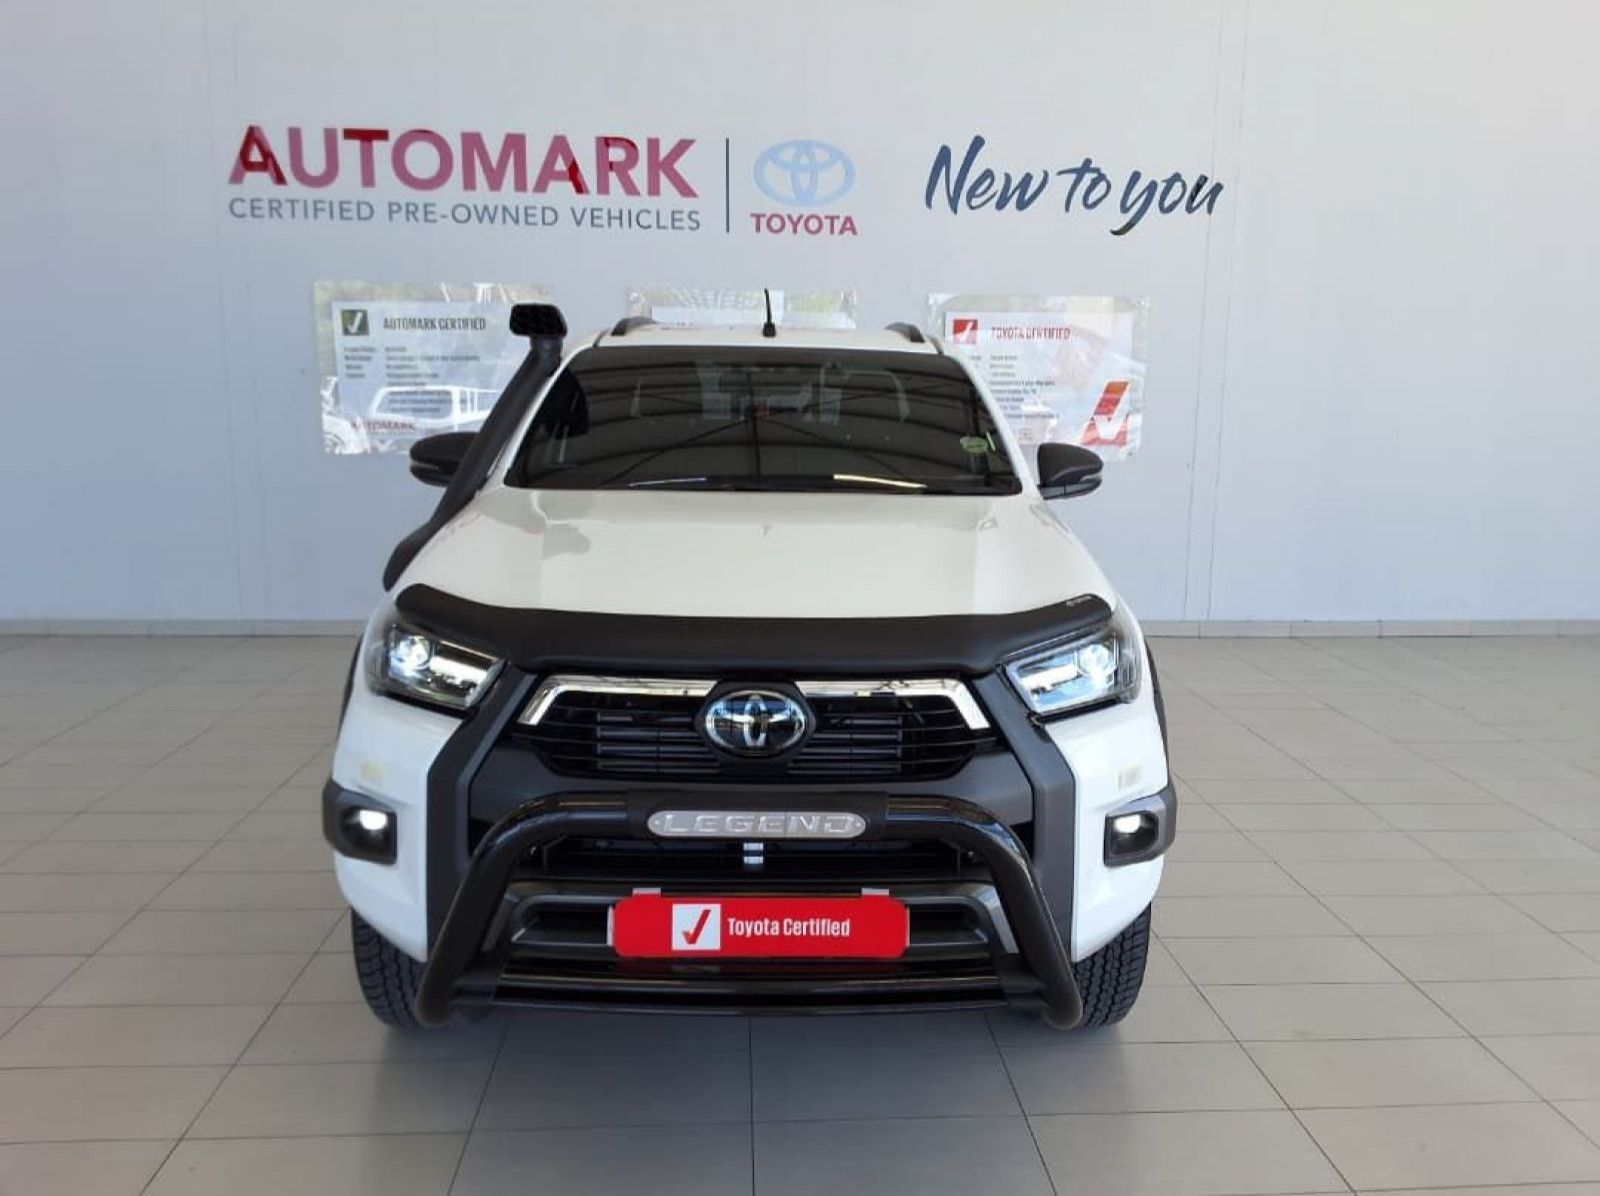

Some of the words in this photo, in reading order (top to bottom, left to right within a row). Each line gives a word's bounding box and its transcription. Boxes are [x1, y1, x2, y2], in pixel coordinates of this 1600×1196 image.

[228, 125, 699, 198] AUTOMARK
[925, 135, 1049, 214] New
[1057, 157, 1112, 214] to
[1110, 170, 1225, 236] you
[228, 198, 375, 222] CERTIFIED
[387, 203, 559, 227] PRE-OWNED
[570, 207, 701, 231] VEHICLES
[750, 213, 858, 236] TOYOTA
[383, 317, 437, 331] AUTOMARK
[661, 813, 854, 833] LEGEND
[727, 917, 780, 938] Toyota
[783, 917, 851, 937] Certified
